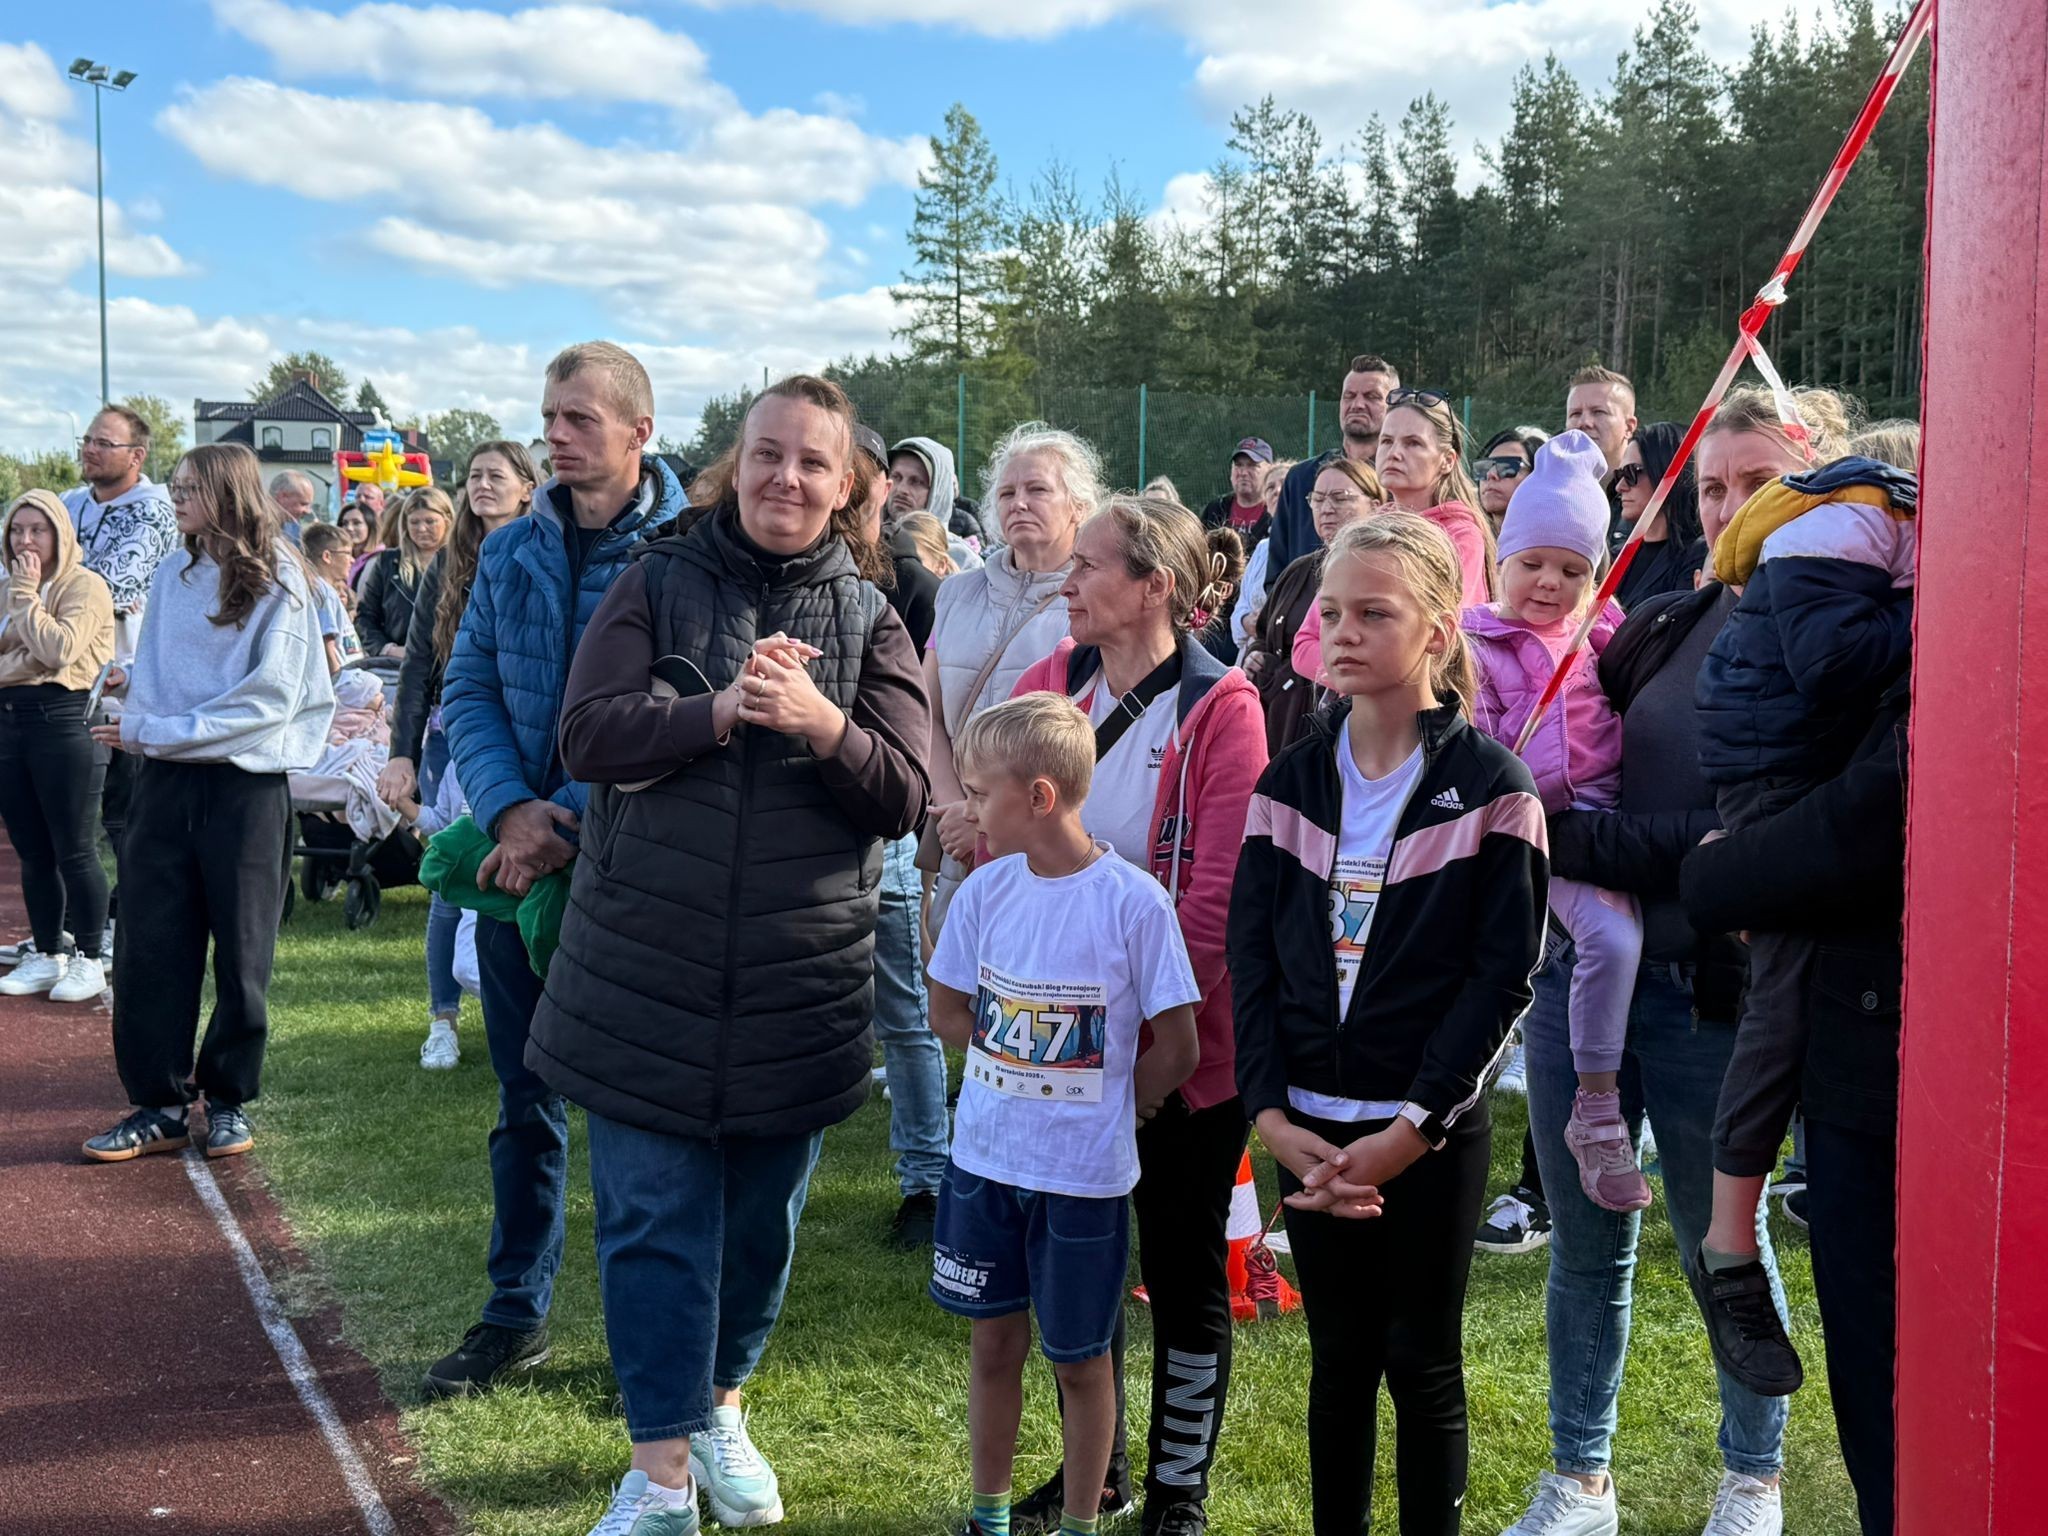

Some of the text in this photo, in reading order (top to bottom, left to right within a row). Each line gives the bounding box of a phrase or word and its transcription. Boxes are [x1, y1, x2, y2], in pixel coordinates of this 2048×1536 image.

[1431, 798, 1464, 810] adidas
[983, 1000, 1077, 1062] 247
[933, 1250, 989, 1287] SURFERS
